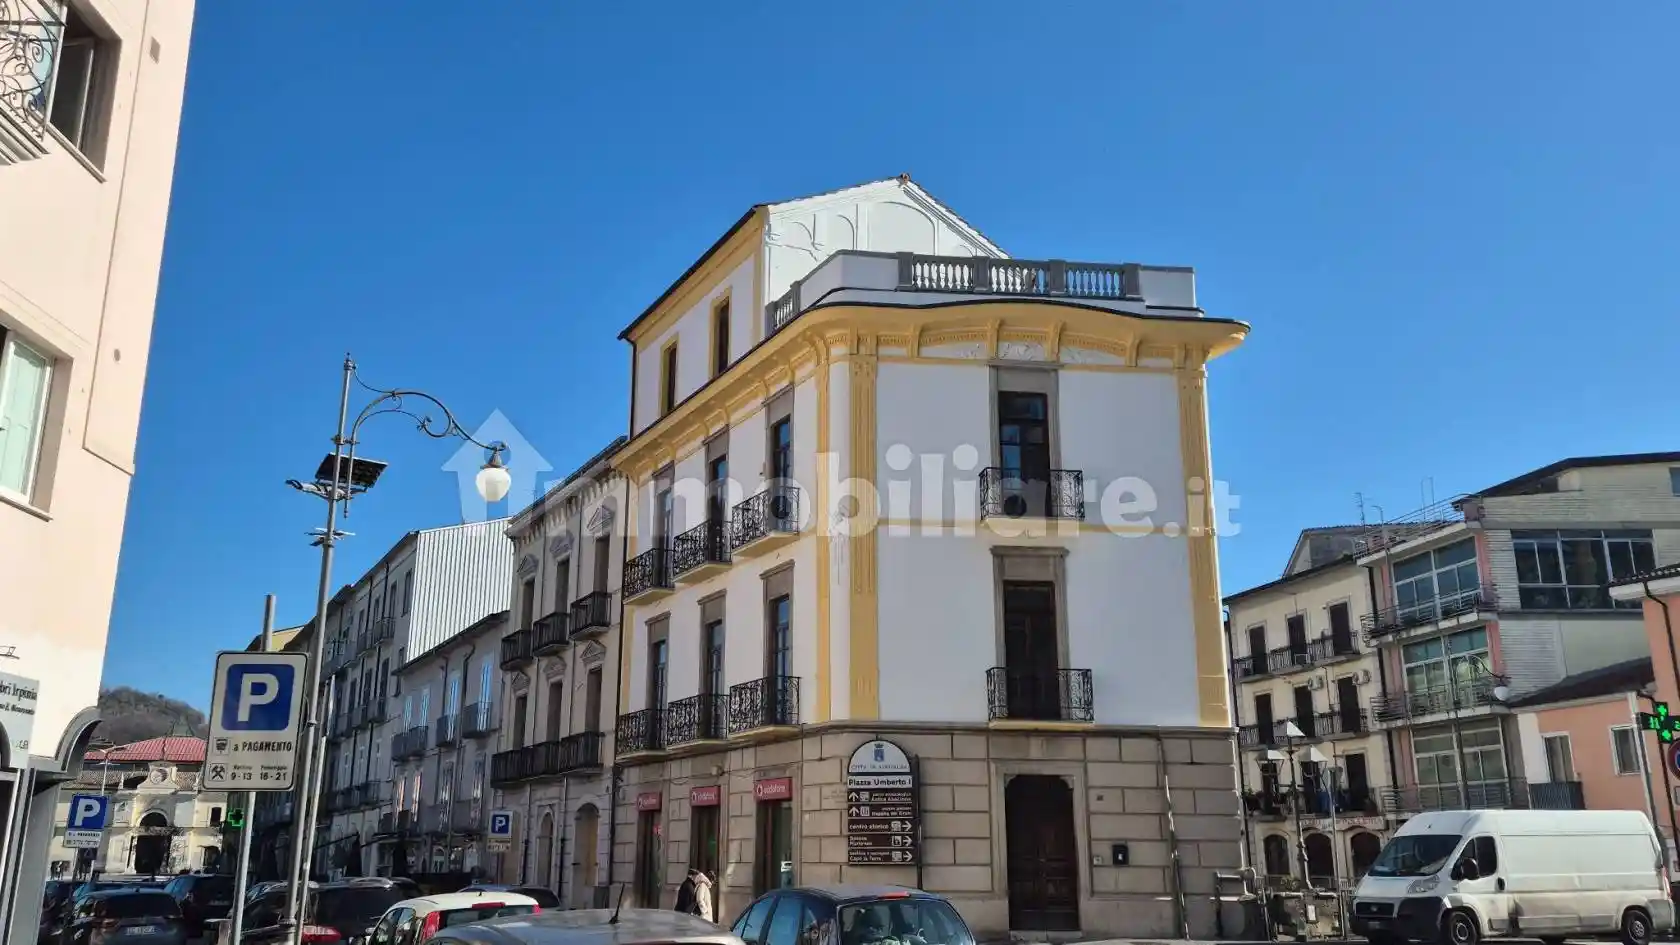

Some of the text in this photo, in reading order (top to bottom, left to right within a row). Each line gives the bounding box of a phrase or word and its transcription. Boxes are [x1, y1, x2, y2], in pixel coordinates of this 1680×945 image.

[237, 673, 279, 722] P
[242, 740, 292, 752] PAGAMENTO
[848, 778, 871, 786] Piazza
[873, 778, 906, 786] Umberto
[74, 798, 101, 827] P
[495, 816, 506, 832] P
